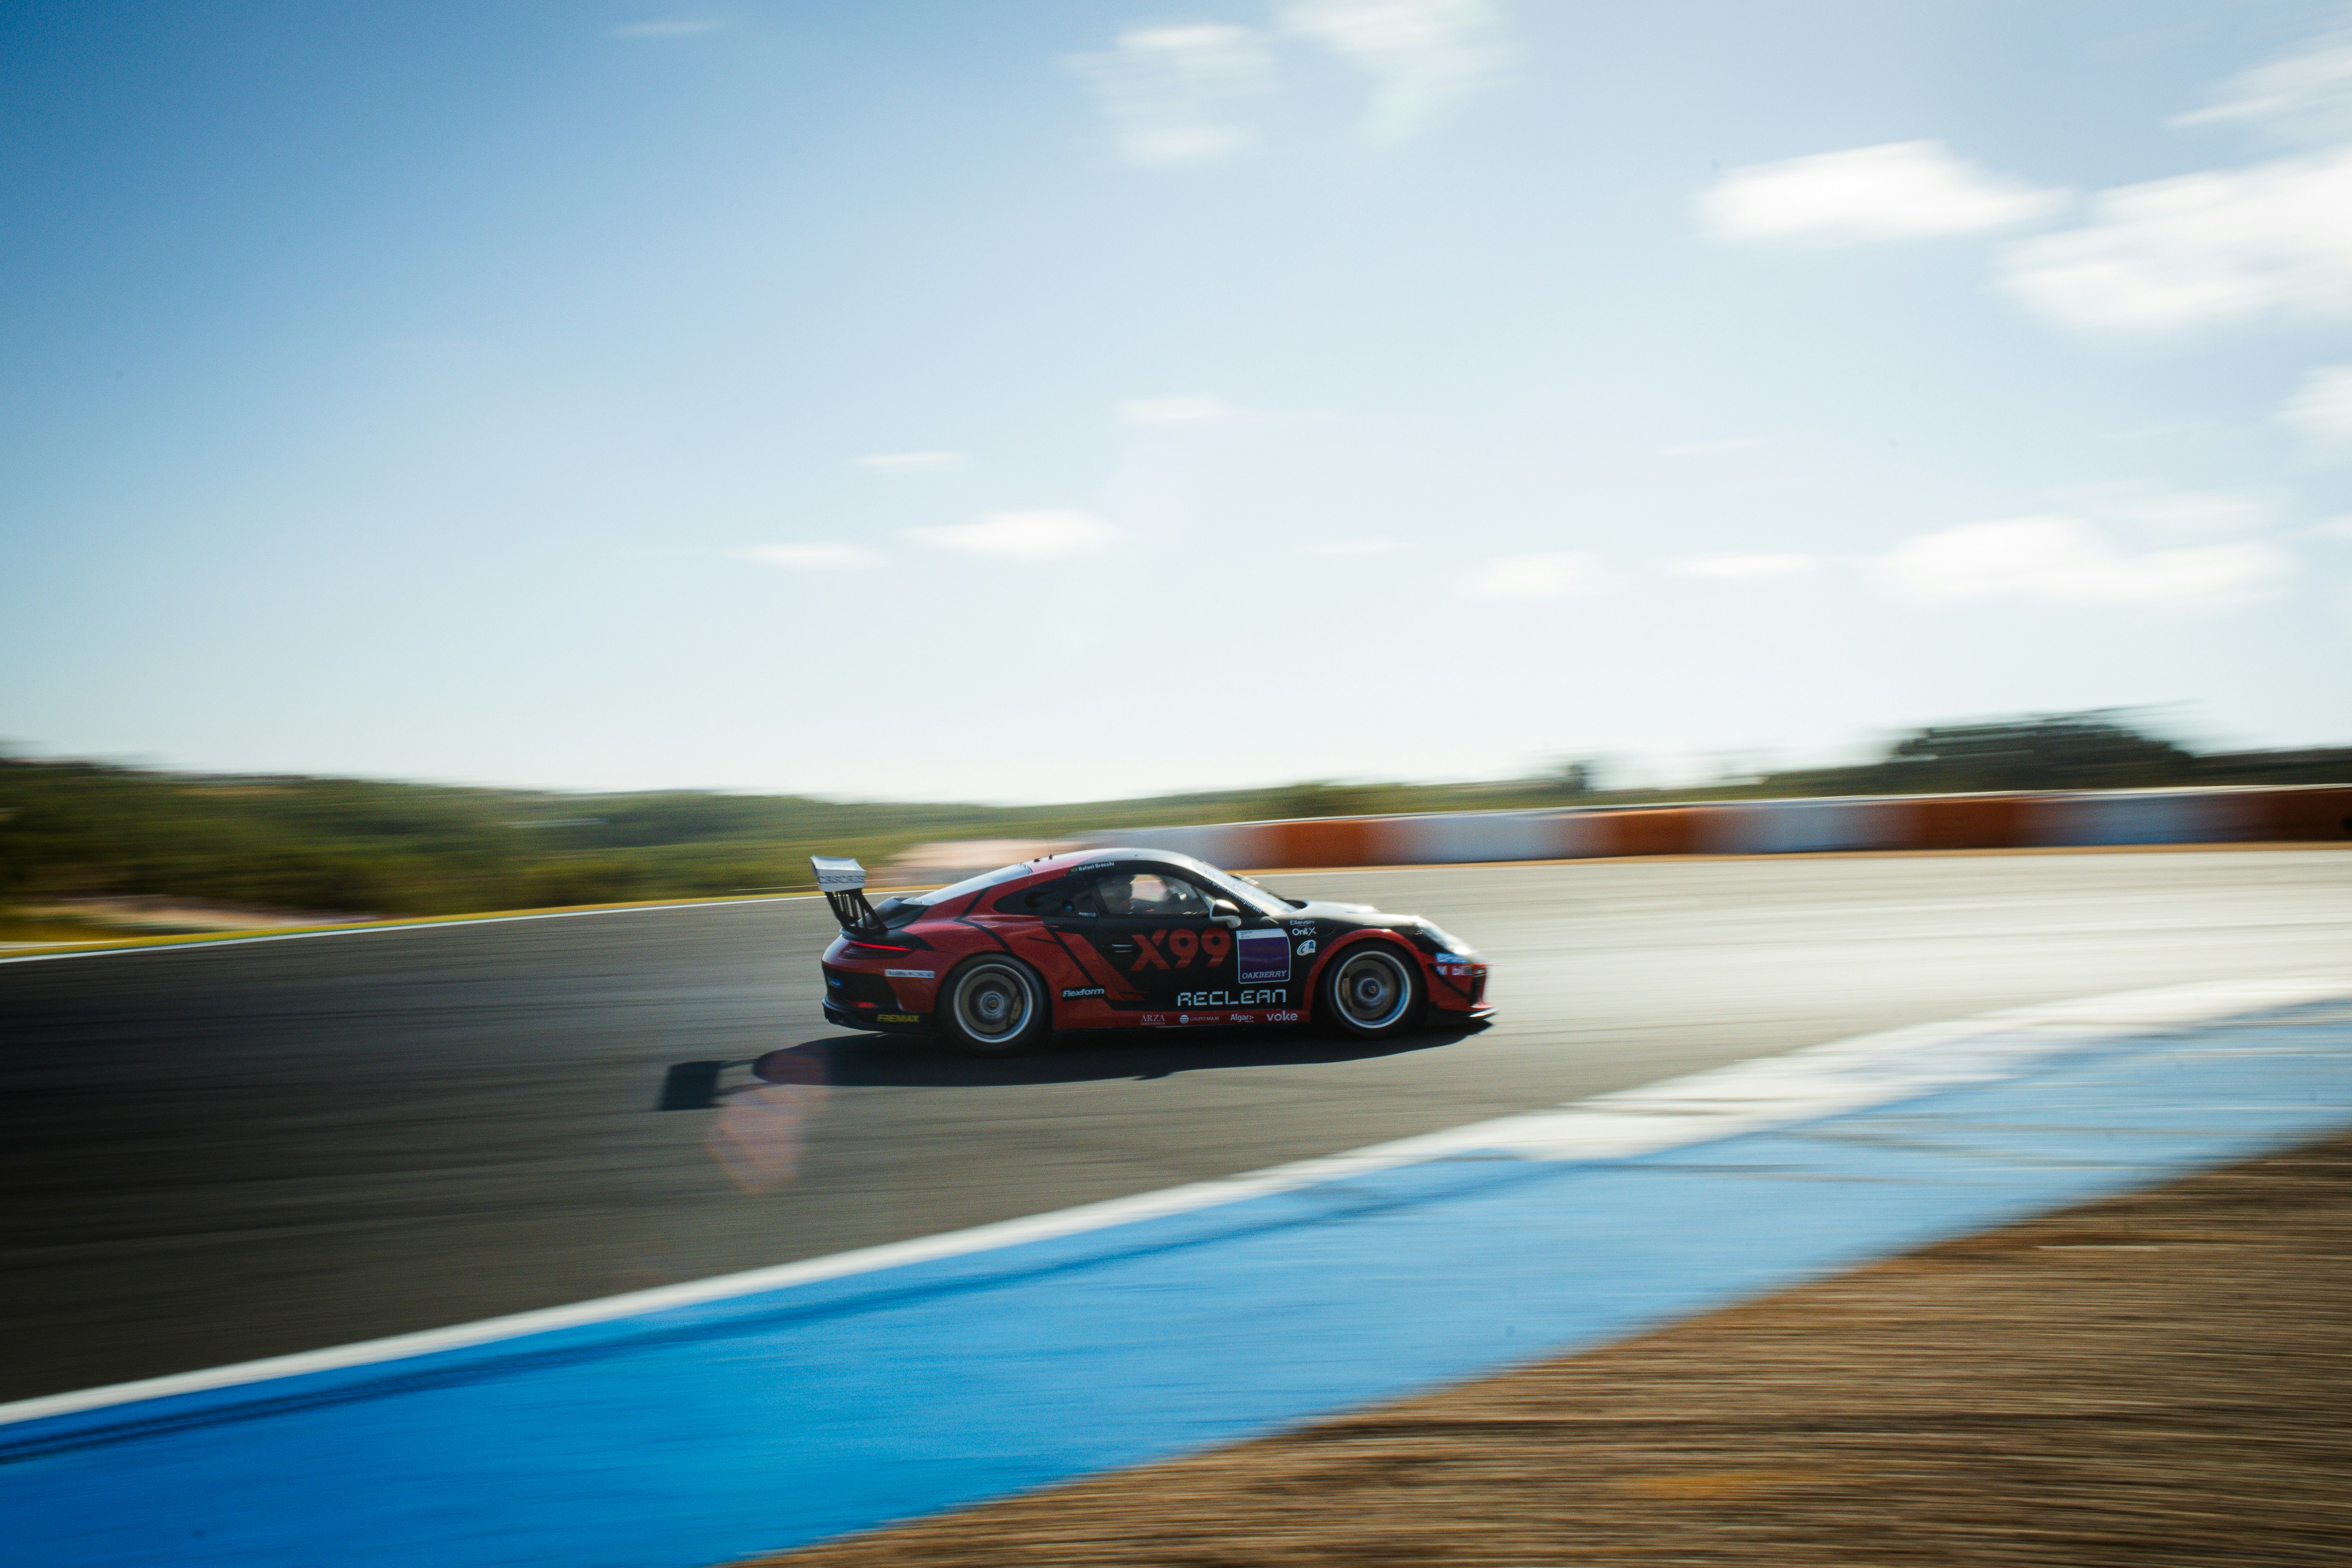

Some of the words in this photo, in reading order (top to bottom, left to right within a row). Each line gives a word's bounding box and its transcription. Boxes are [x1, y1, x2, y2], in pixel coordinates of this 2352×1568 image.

[1130, 927, 1231, 970] X99
[1242, 970, 1286, 979] OAKBERRY
[1062, 988, 1104, 997] Flexform
[1177, 989, 1286, 1006] RECLEAN
[1230, 1014, 1249, 1022] Algar
[1267, 1011, 1298, 1021] voke
